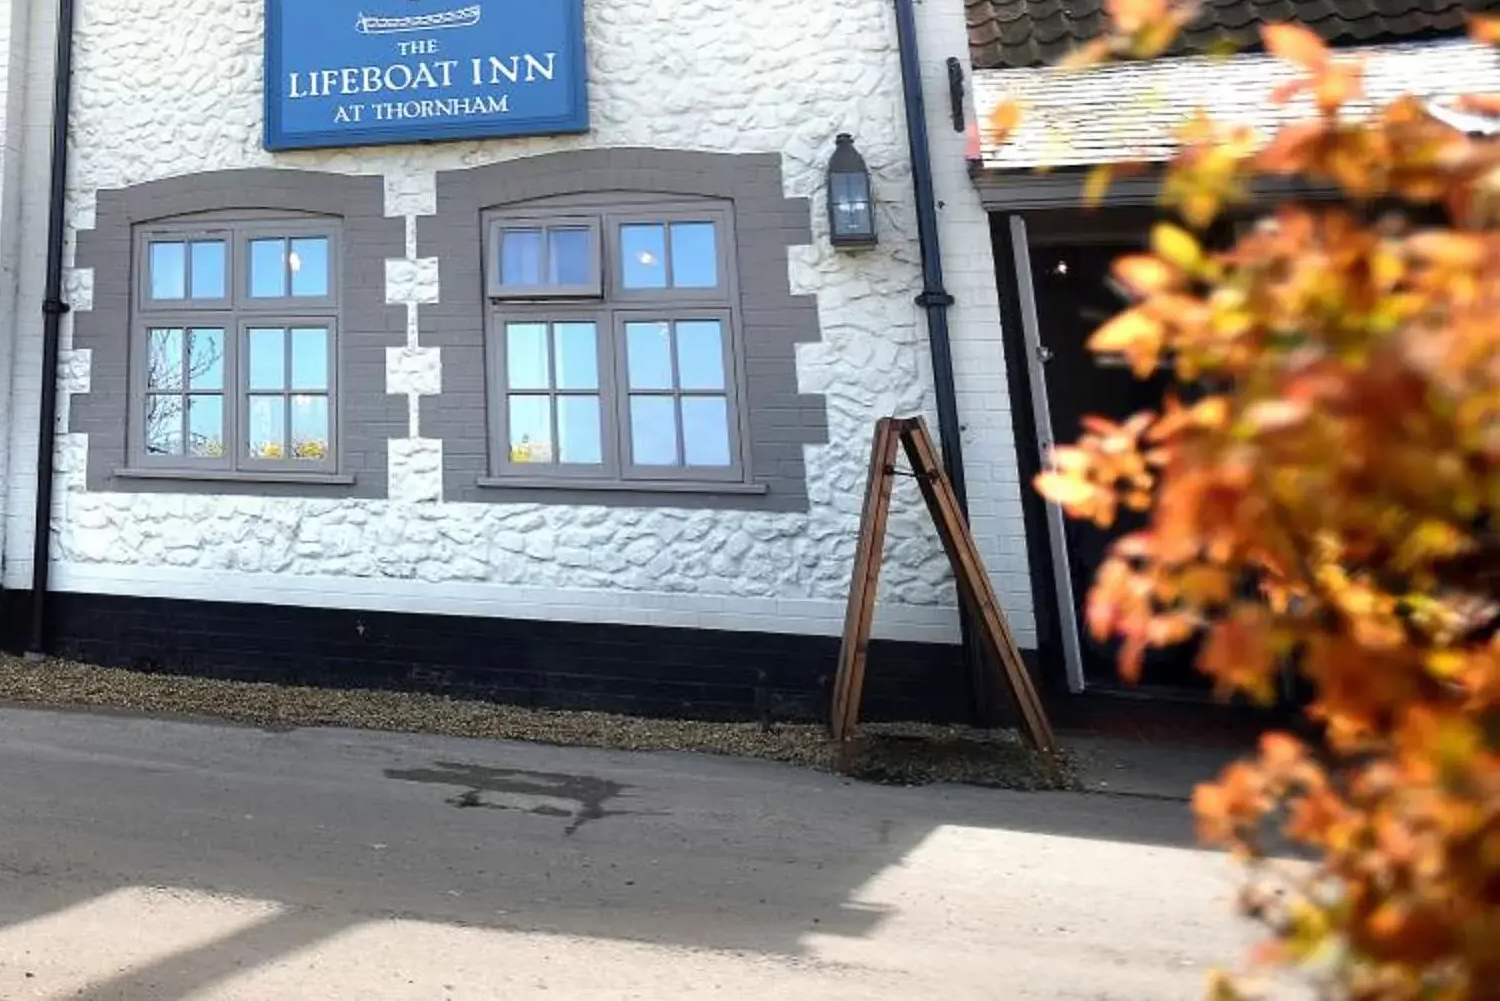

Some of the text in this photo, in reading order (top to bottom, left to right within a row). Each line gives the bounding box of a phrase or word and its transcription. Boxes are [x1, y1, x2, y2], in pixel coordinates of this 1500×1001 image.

[398, 39, 439, 55] THE
[289, 52, 556, 98] LIFEBOAT INN
[334, 94, 510, 123] AT THORNHAM
